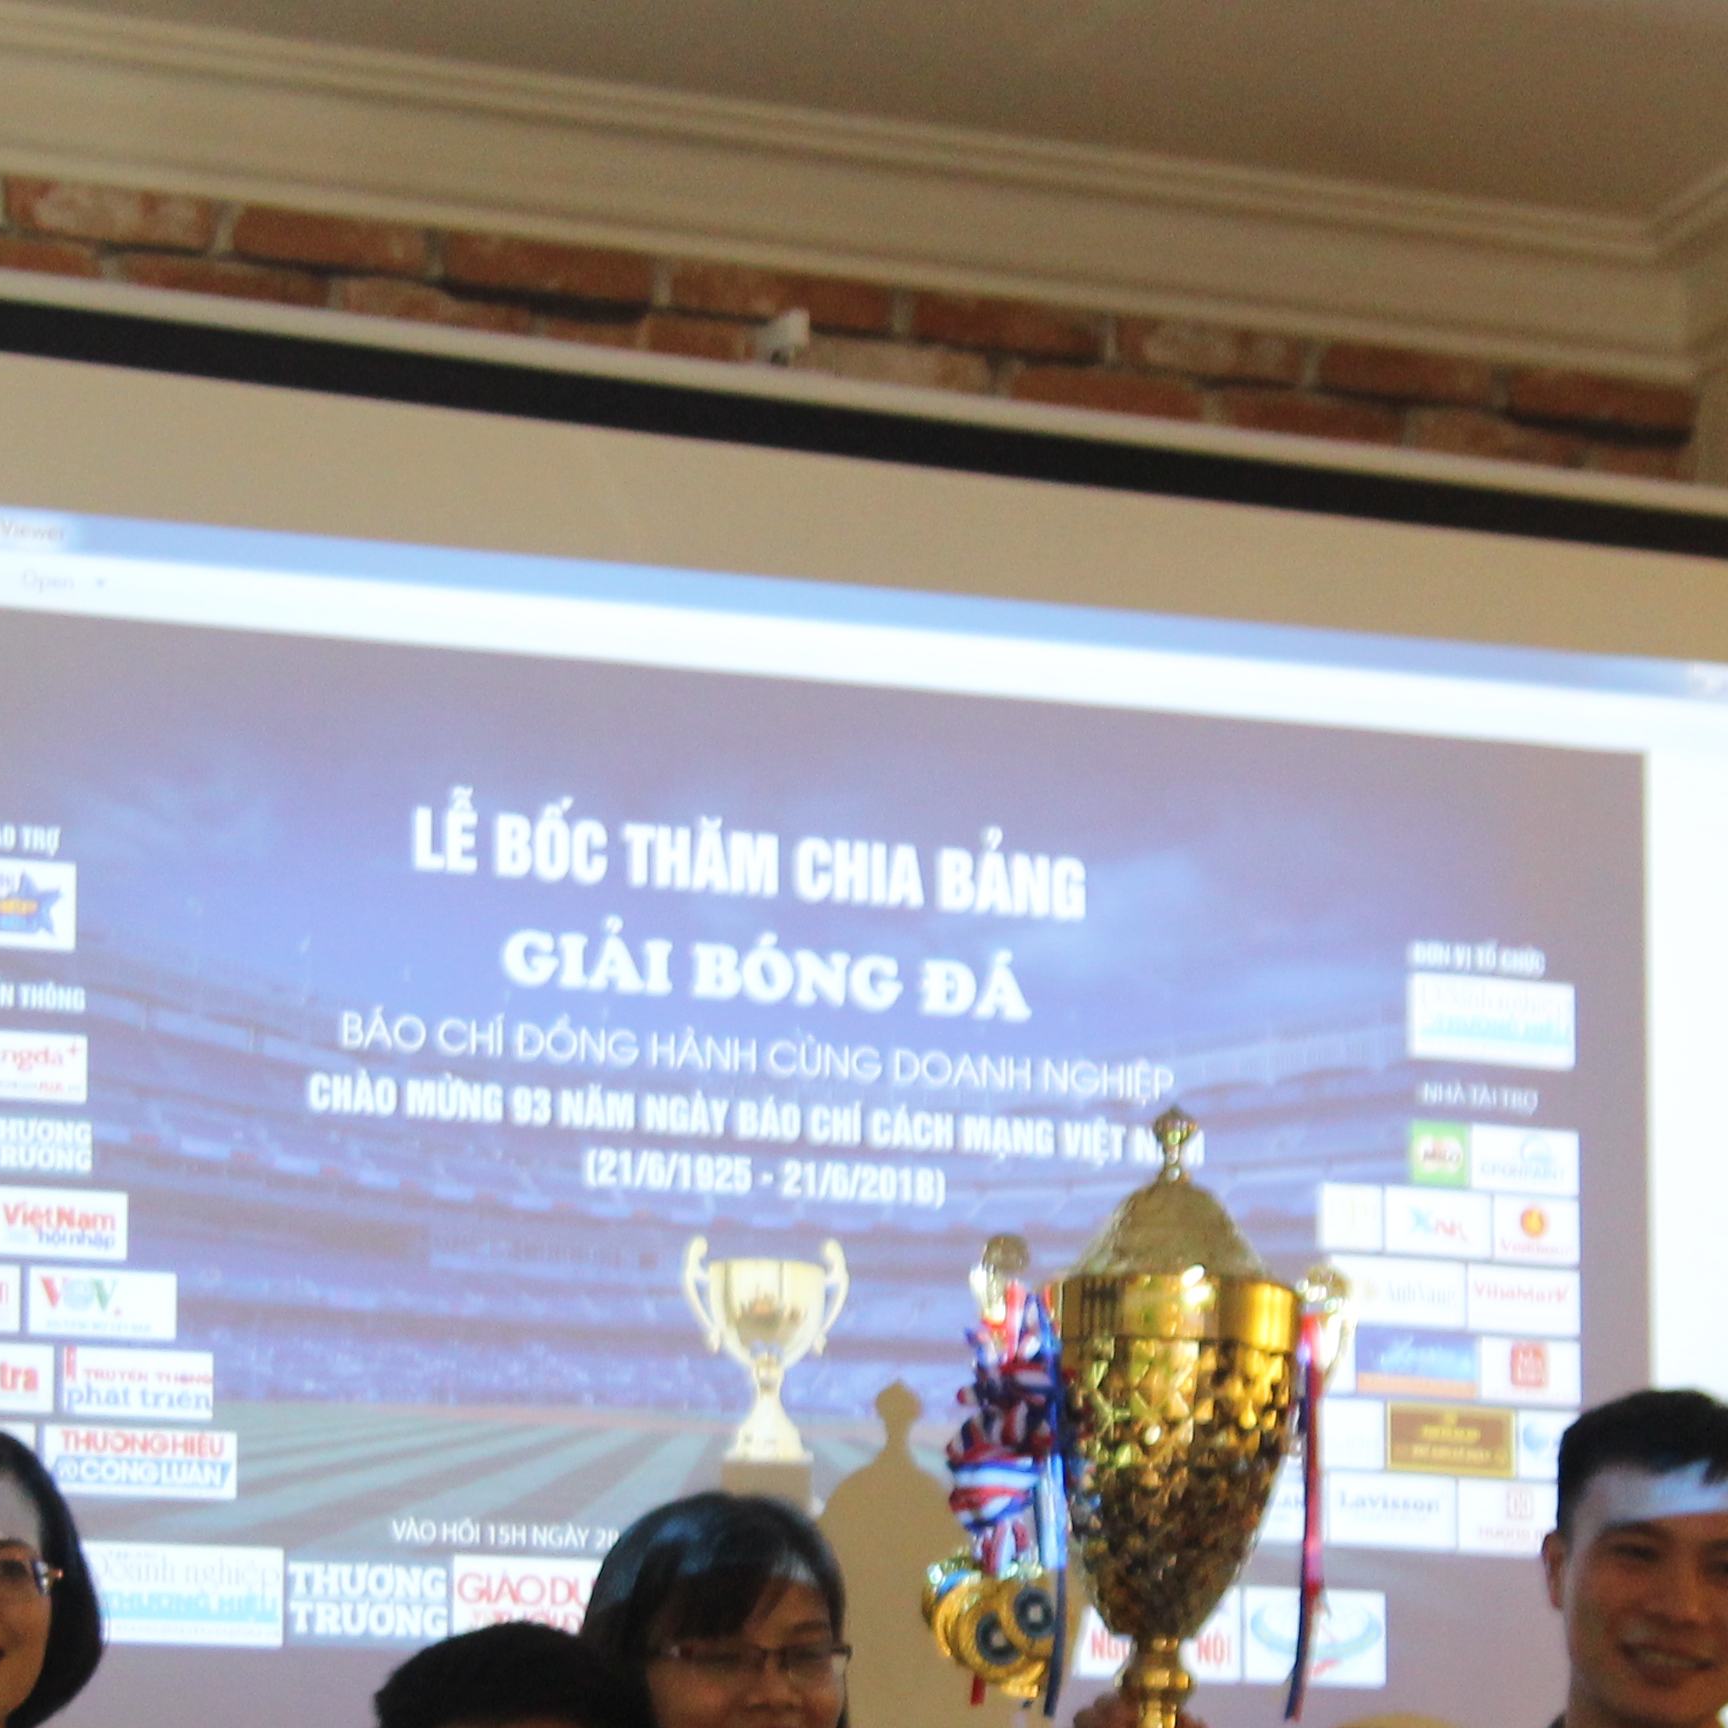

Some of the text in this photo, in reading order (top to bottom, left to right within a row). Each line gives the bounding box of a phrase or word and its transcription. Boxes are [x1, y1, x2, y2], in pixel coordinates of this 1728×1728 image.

[413, 786, 1086, 921] LỄ BỐC THĂM CHIA BẢNG
[503, 914, 1033, 1022] GIẢI BÓNG ĐÁ
[341, 1005, 427, 1053] BÁO
[437, 1013, 505, 1057] CHÍ
[650, 1025, 757, 1074] HÀNH
[768, 1034, 883, 1084] CÙNG
[893, 1049, 1032, 1092] DOANH
[1042, 1058, 1175, 1106] NGHIỆP
[308, 1065, 1206, 1169] CHÀO MỪNG 93 NĂM NGÀY BÁO CHÍ CÁCH MẠNG VIỆT NM
[585, 1148, 753, 1197] (21/6/1925
[781, 1159, 947, 1211] 21/6/2018)
[0, 1362, 39, 1393] tra
[392, 1518, 437, 1543] VÀO
[487, 1524, 528, 1546] 15H
[532, 1524, 589, 1549] NGÀY
